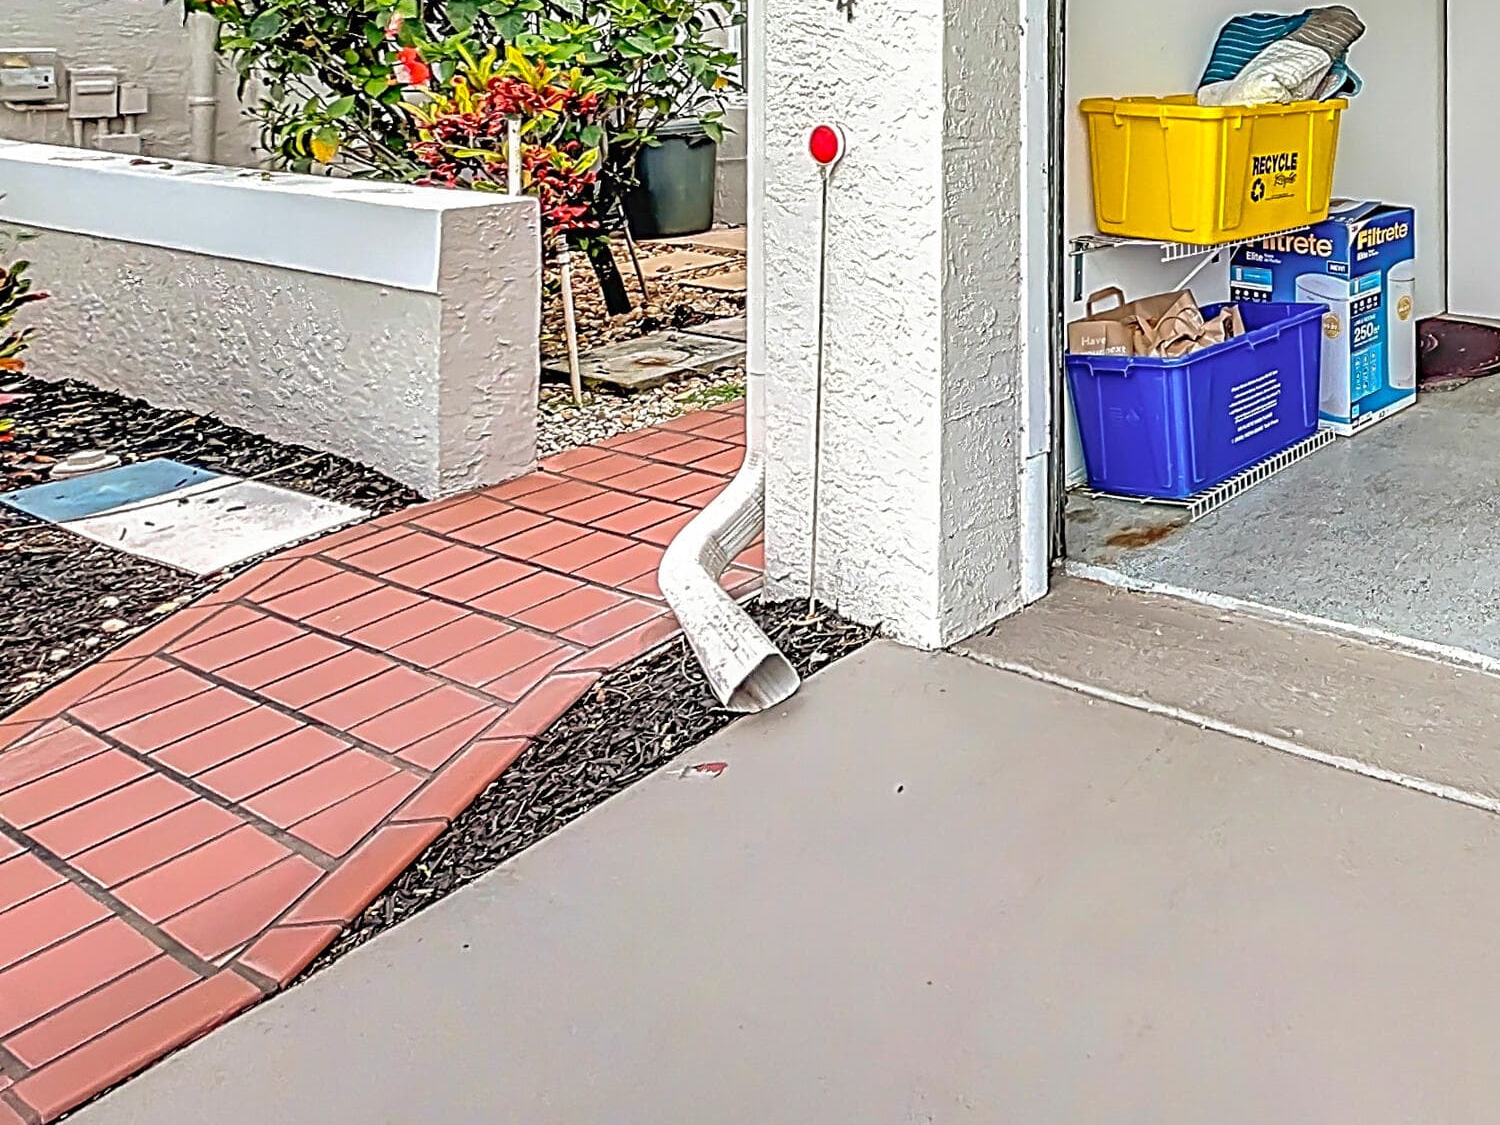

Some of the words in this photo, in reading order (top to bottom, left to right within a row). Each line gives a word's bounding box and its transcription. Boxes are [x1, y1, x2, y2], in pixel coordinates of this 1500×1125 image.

[1252, 152, 1298, 176] RECYCLE
[1246, 234, 1333, 257] iltrete
[1357, 222, 1408, 250] Filtrete
[1081, 336, 1106, 346] Have
[1354, 322, 1373, 343] 250
